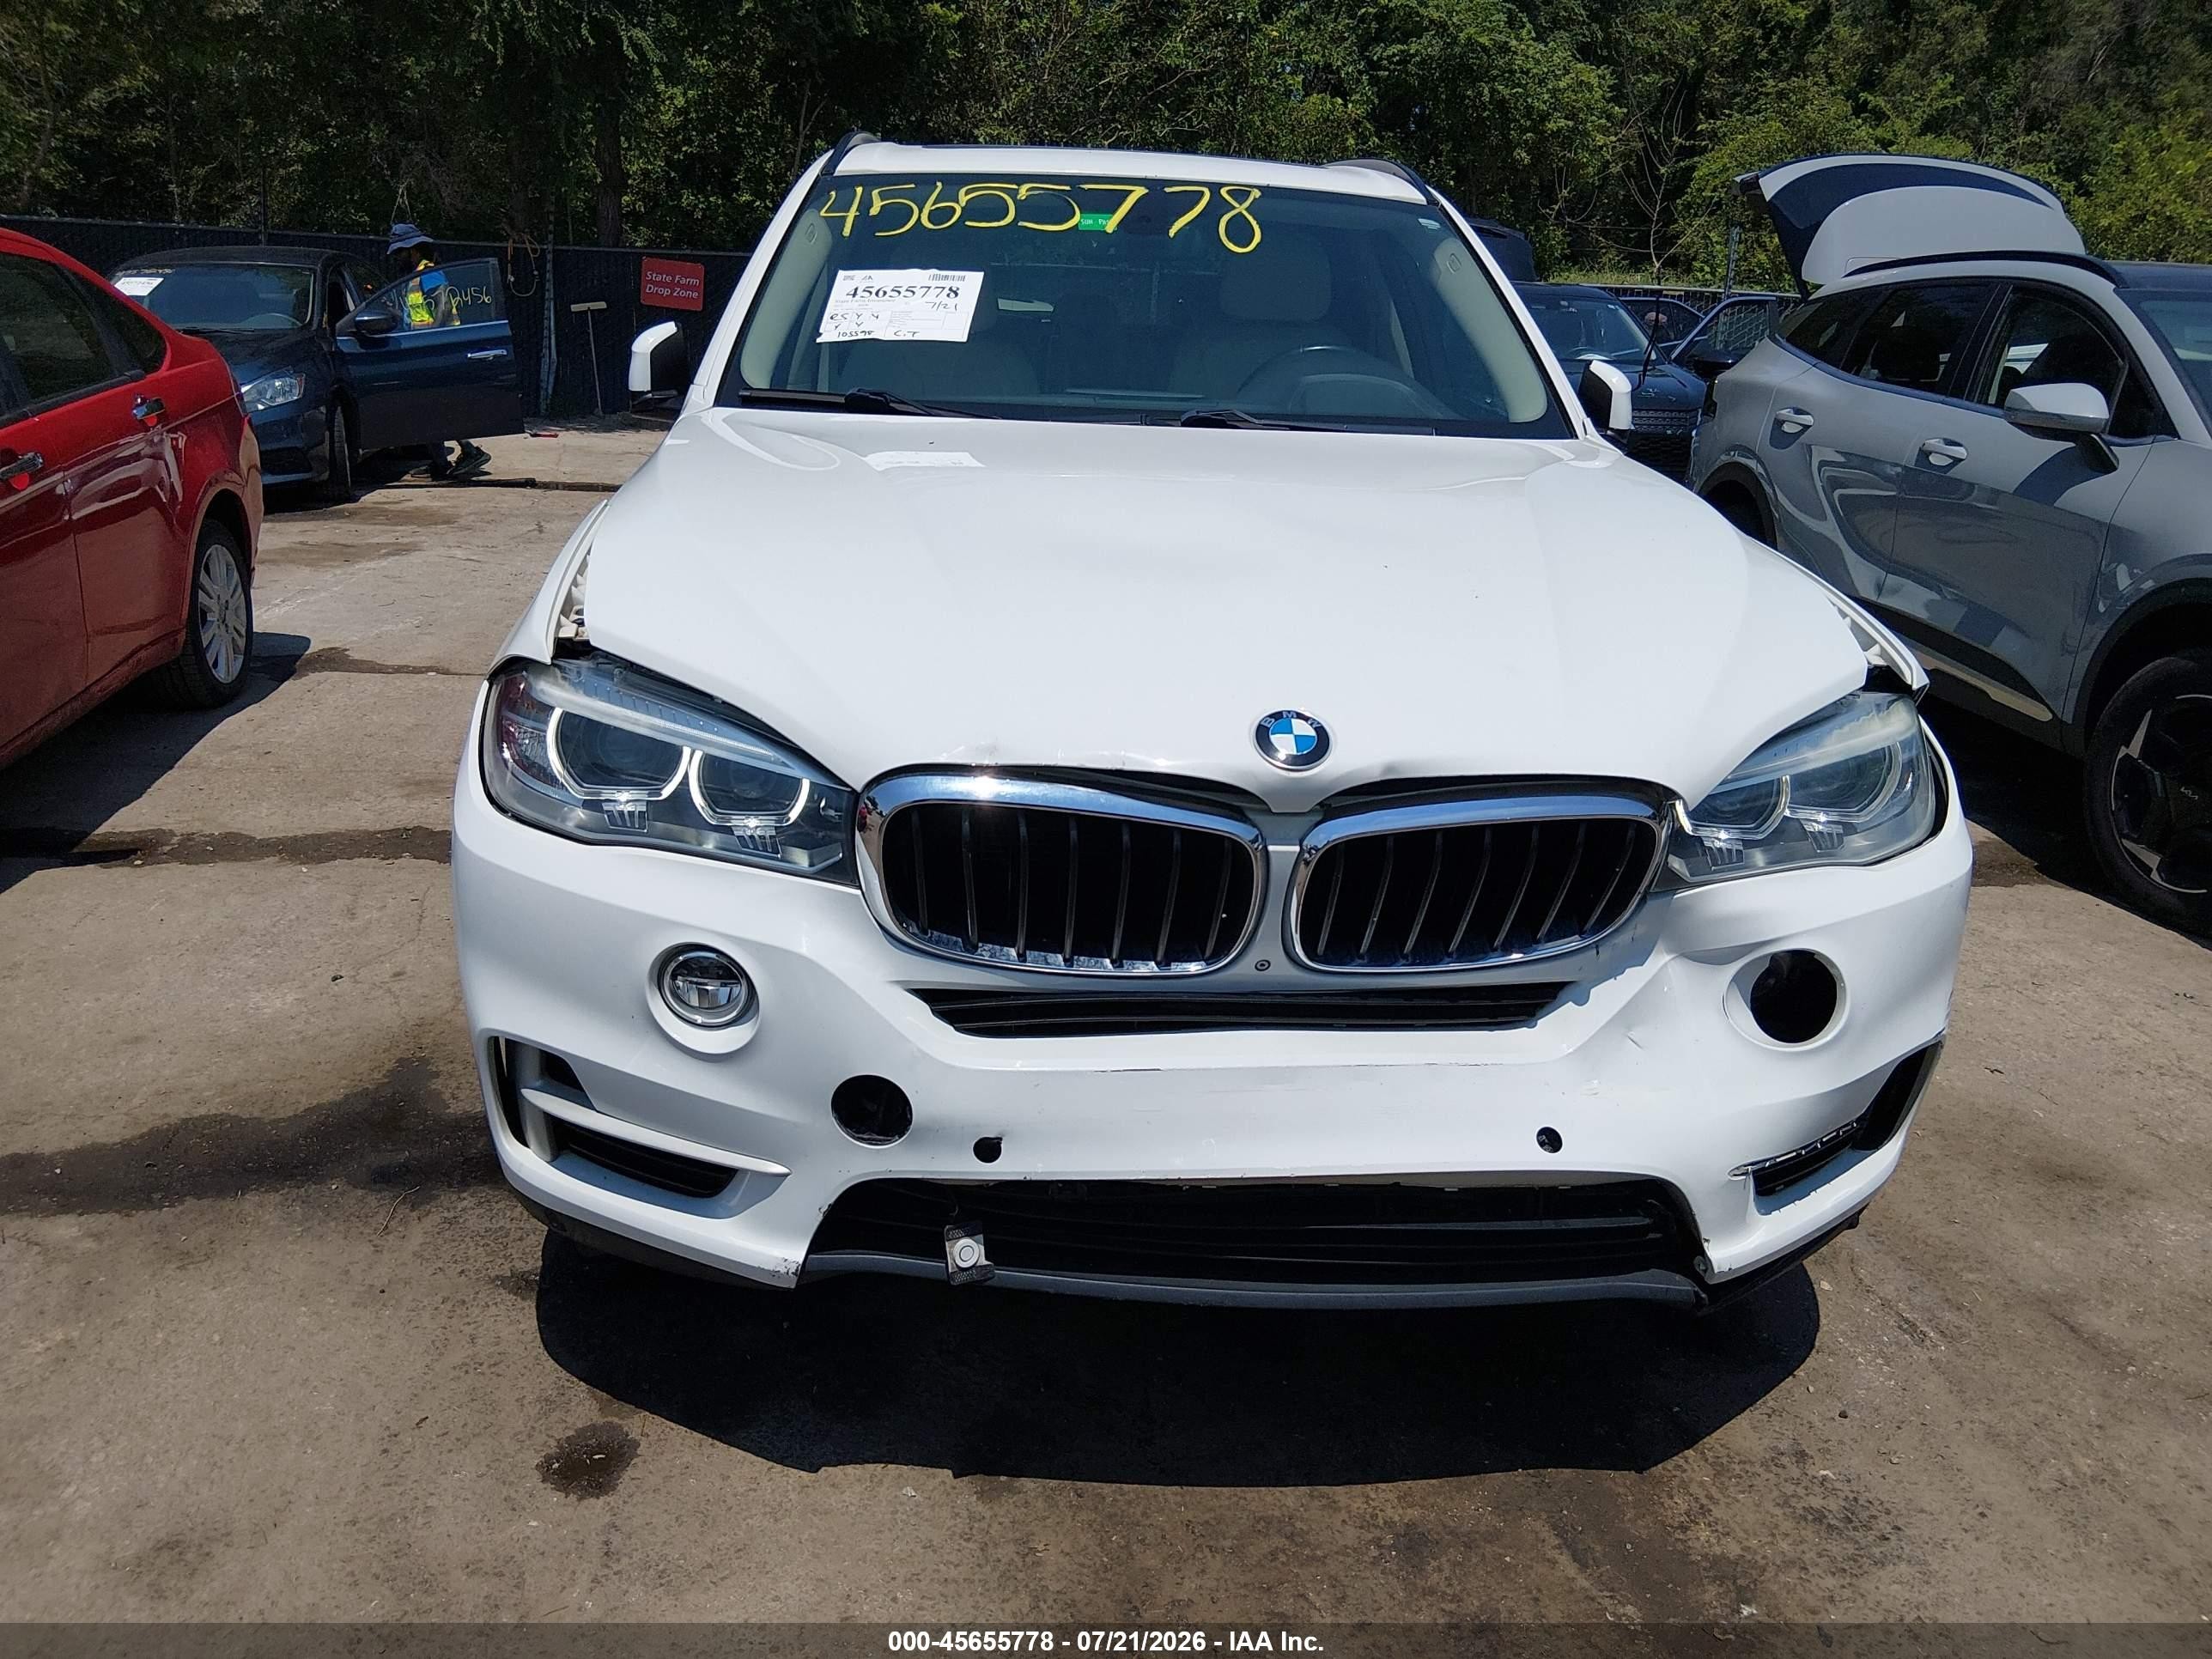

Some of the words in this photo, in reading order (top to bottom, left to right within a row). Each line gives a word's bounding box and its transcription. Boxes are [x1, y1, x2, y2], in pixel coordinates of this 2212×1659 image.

[820, 181, 1261, 254] 45655778
[646, 270, 672, 283] State
[674, 275, 700, 286] Farm
[646, 283, 671, 297] Drop
[673, 288, 699, 299] Zone
[846, 285, 960, 299] 45655778
[925, 301, 958, 312] 7/21
[1261, 711, 1322, 728] BMW
